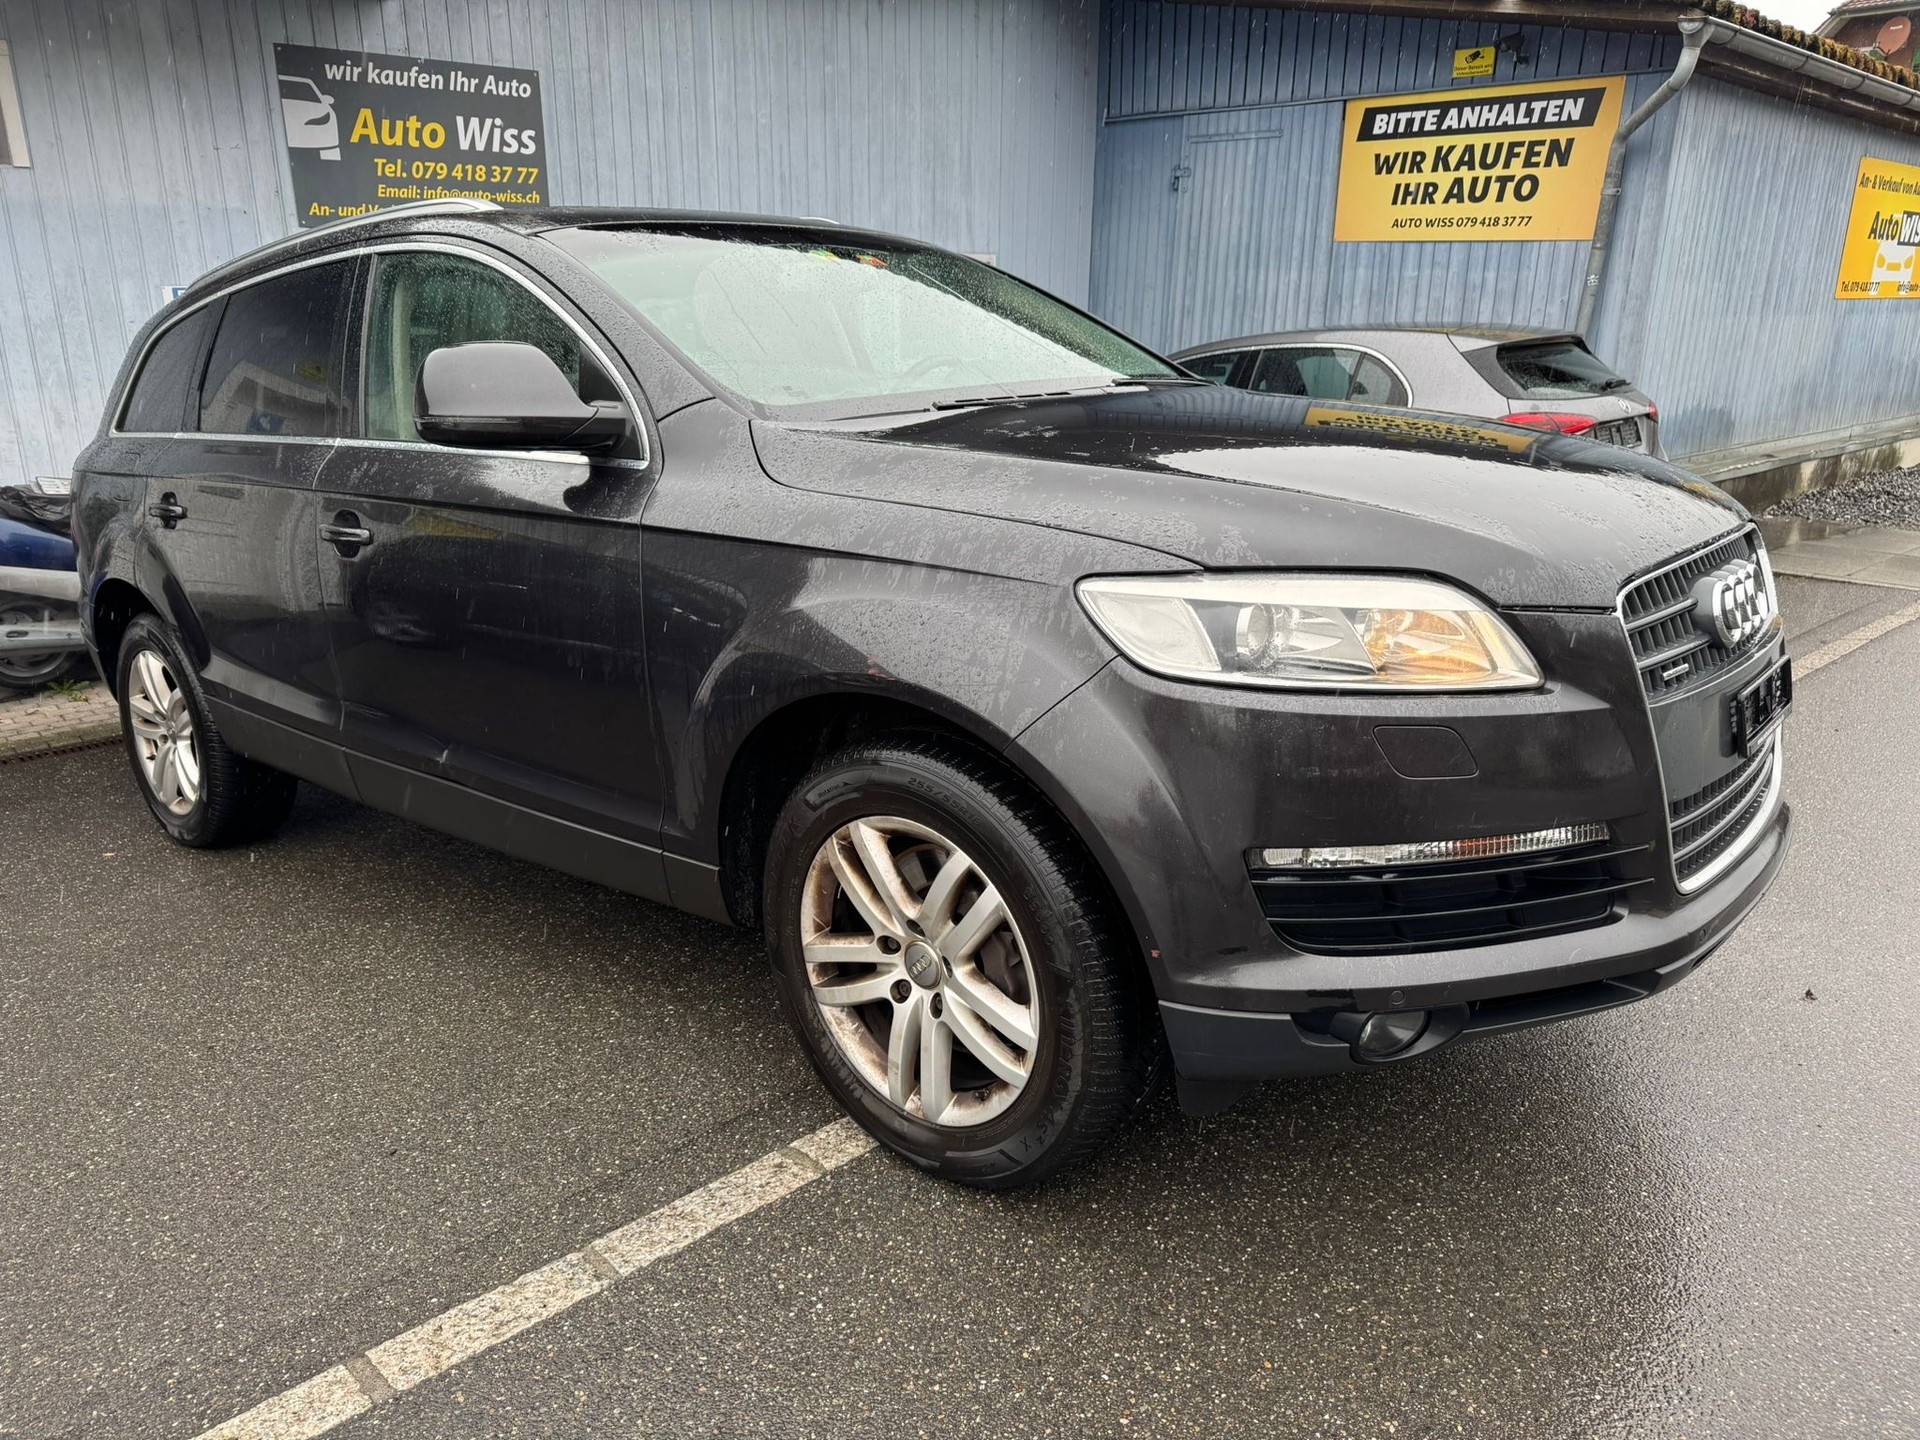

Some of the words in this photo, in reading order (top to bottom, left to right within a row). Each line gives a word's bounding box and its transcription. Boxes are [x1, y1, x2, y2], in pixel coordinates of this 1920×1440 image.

[325, 60, 361, 82] wir
[367, 62, 444, 89] kaufen
[449, 71, 479, 93] Ihr
[482, 75, 532, 98] Auto
[350, 107, 446, 149] Auto
[455, 115, 536, 155] Wiss
[1372, 109, 1441, 135] BITTE
[1440, 97, 1585, 130] ANHALTEN
[374, 158, 407, 178] Tel.
[412, 161, 447, 180] 079
[452, 163, 486, 182] 418
[490, 166, 516, 184] 37
[517, 167, 539, 185] 77
[1374, 150, 1427, 176] WIR
[1430, 137, 1576, 173] KAUFEN
[377, 184, 421, 200] Email:
[1391, 182, 1439, 206] IHR
[1441, 174, 1540, 205] AUTO
[1878, 174, 1904, 193] Verkauf
[309, 202, 335, 216] An-
[338, 203, 366, 217] und
[1391, 217, 1423, 229] AUTO
[1425, 216, 1455, 228] WISS
[1456, 216, 1478, 228] 079
[1479, 216, 1500, 227] 418
[1502, 215, 1517, 227] 37
[1517, 215, 1533, 227] 77
[1867, 210, 1899, 240] Auto
